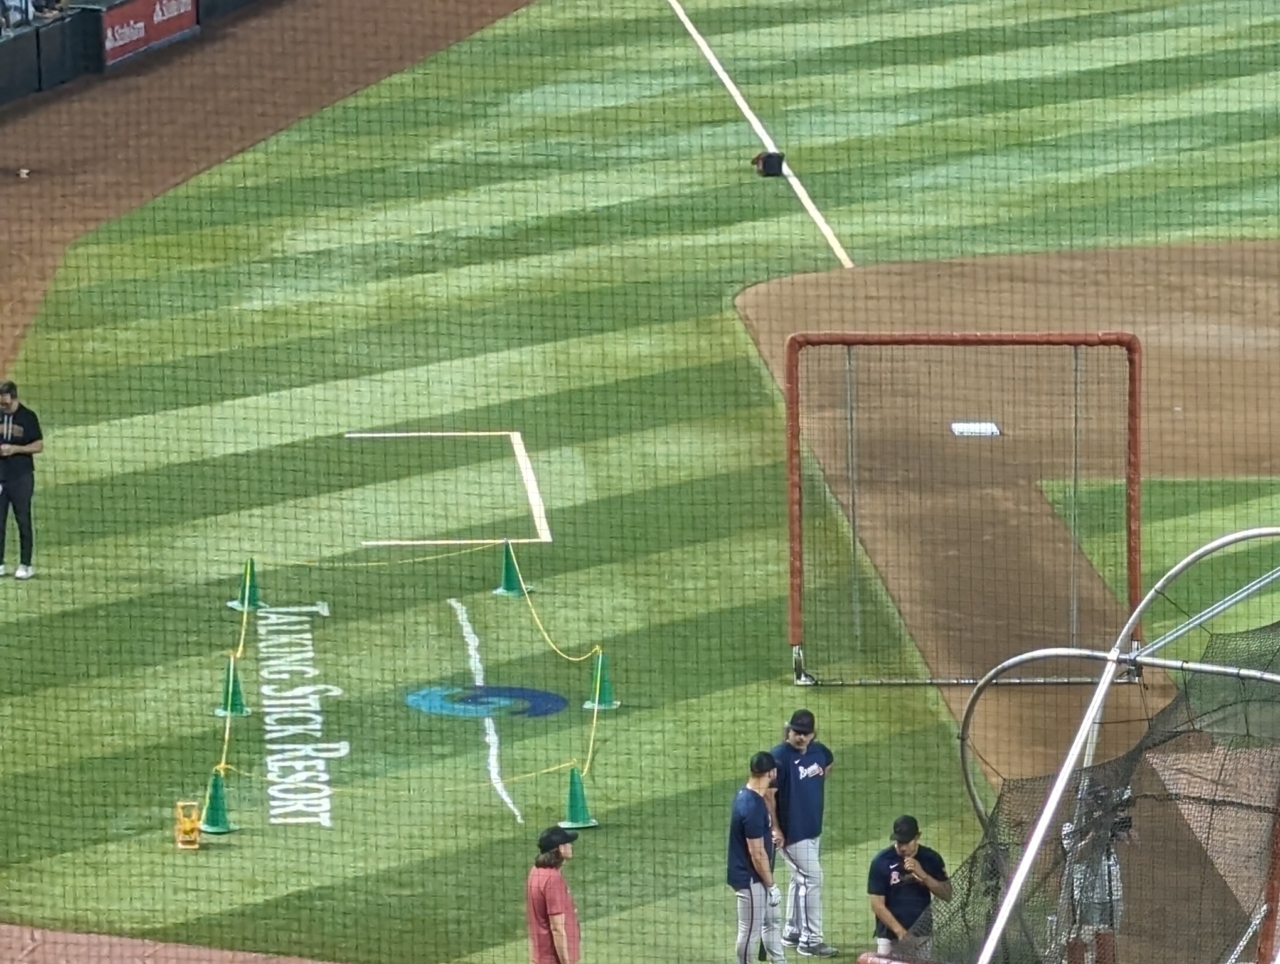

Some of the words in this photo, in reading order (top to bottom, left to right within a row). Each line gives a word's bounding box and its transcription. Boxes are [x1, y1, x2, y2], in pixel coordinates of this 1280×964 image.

[257, 602, 330, 679] TALKING
[260, 684, 343, 740] STICK
[265, 741, 350, 827] RESORT
